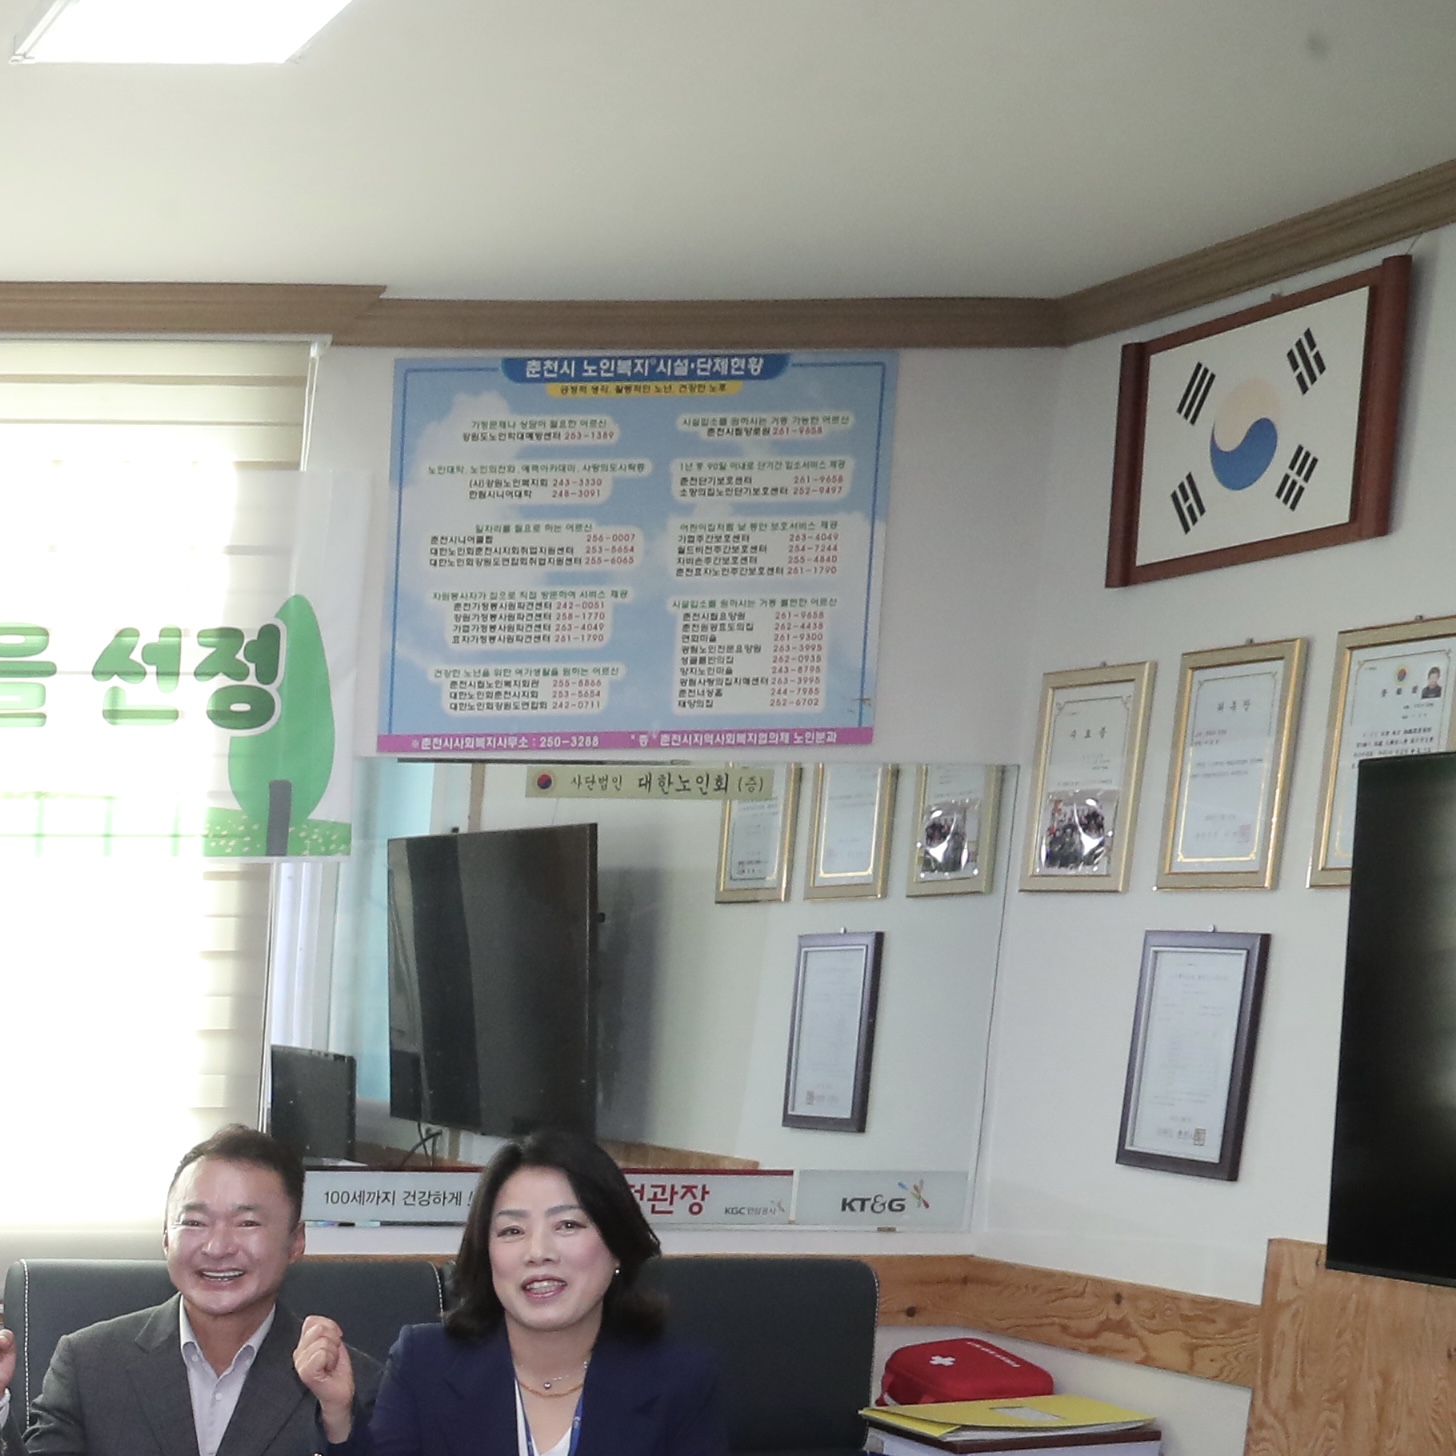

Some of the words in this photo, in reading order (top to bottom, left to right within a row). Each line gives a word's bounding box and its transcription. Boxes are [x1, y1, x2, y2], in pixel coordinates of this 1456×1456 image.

[526, 359, 576, 378] 춘천시
[583, 358, 648, 377] 노인복지
[91, 624, 286, 731] 선정
[551, 700, 601, 709] 242-0711
[539, 735, 599, 748] 250-3288
[570, 773, 625, 791] 사단법인
[637, 772, 731, 796] 대한노인회
[323, 1188, 397, 1208] 100세까지
[401, 1188, 465, 1208] 건강하게
[840, 1195, 907, 1213] KT&G
[724, 1206, 746, 1215] KGC
